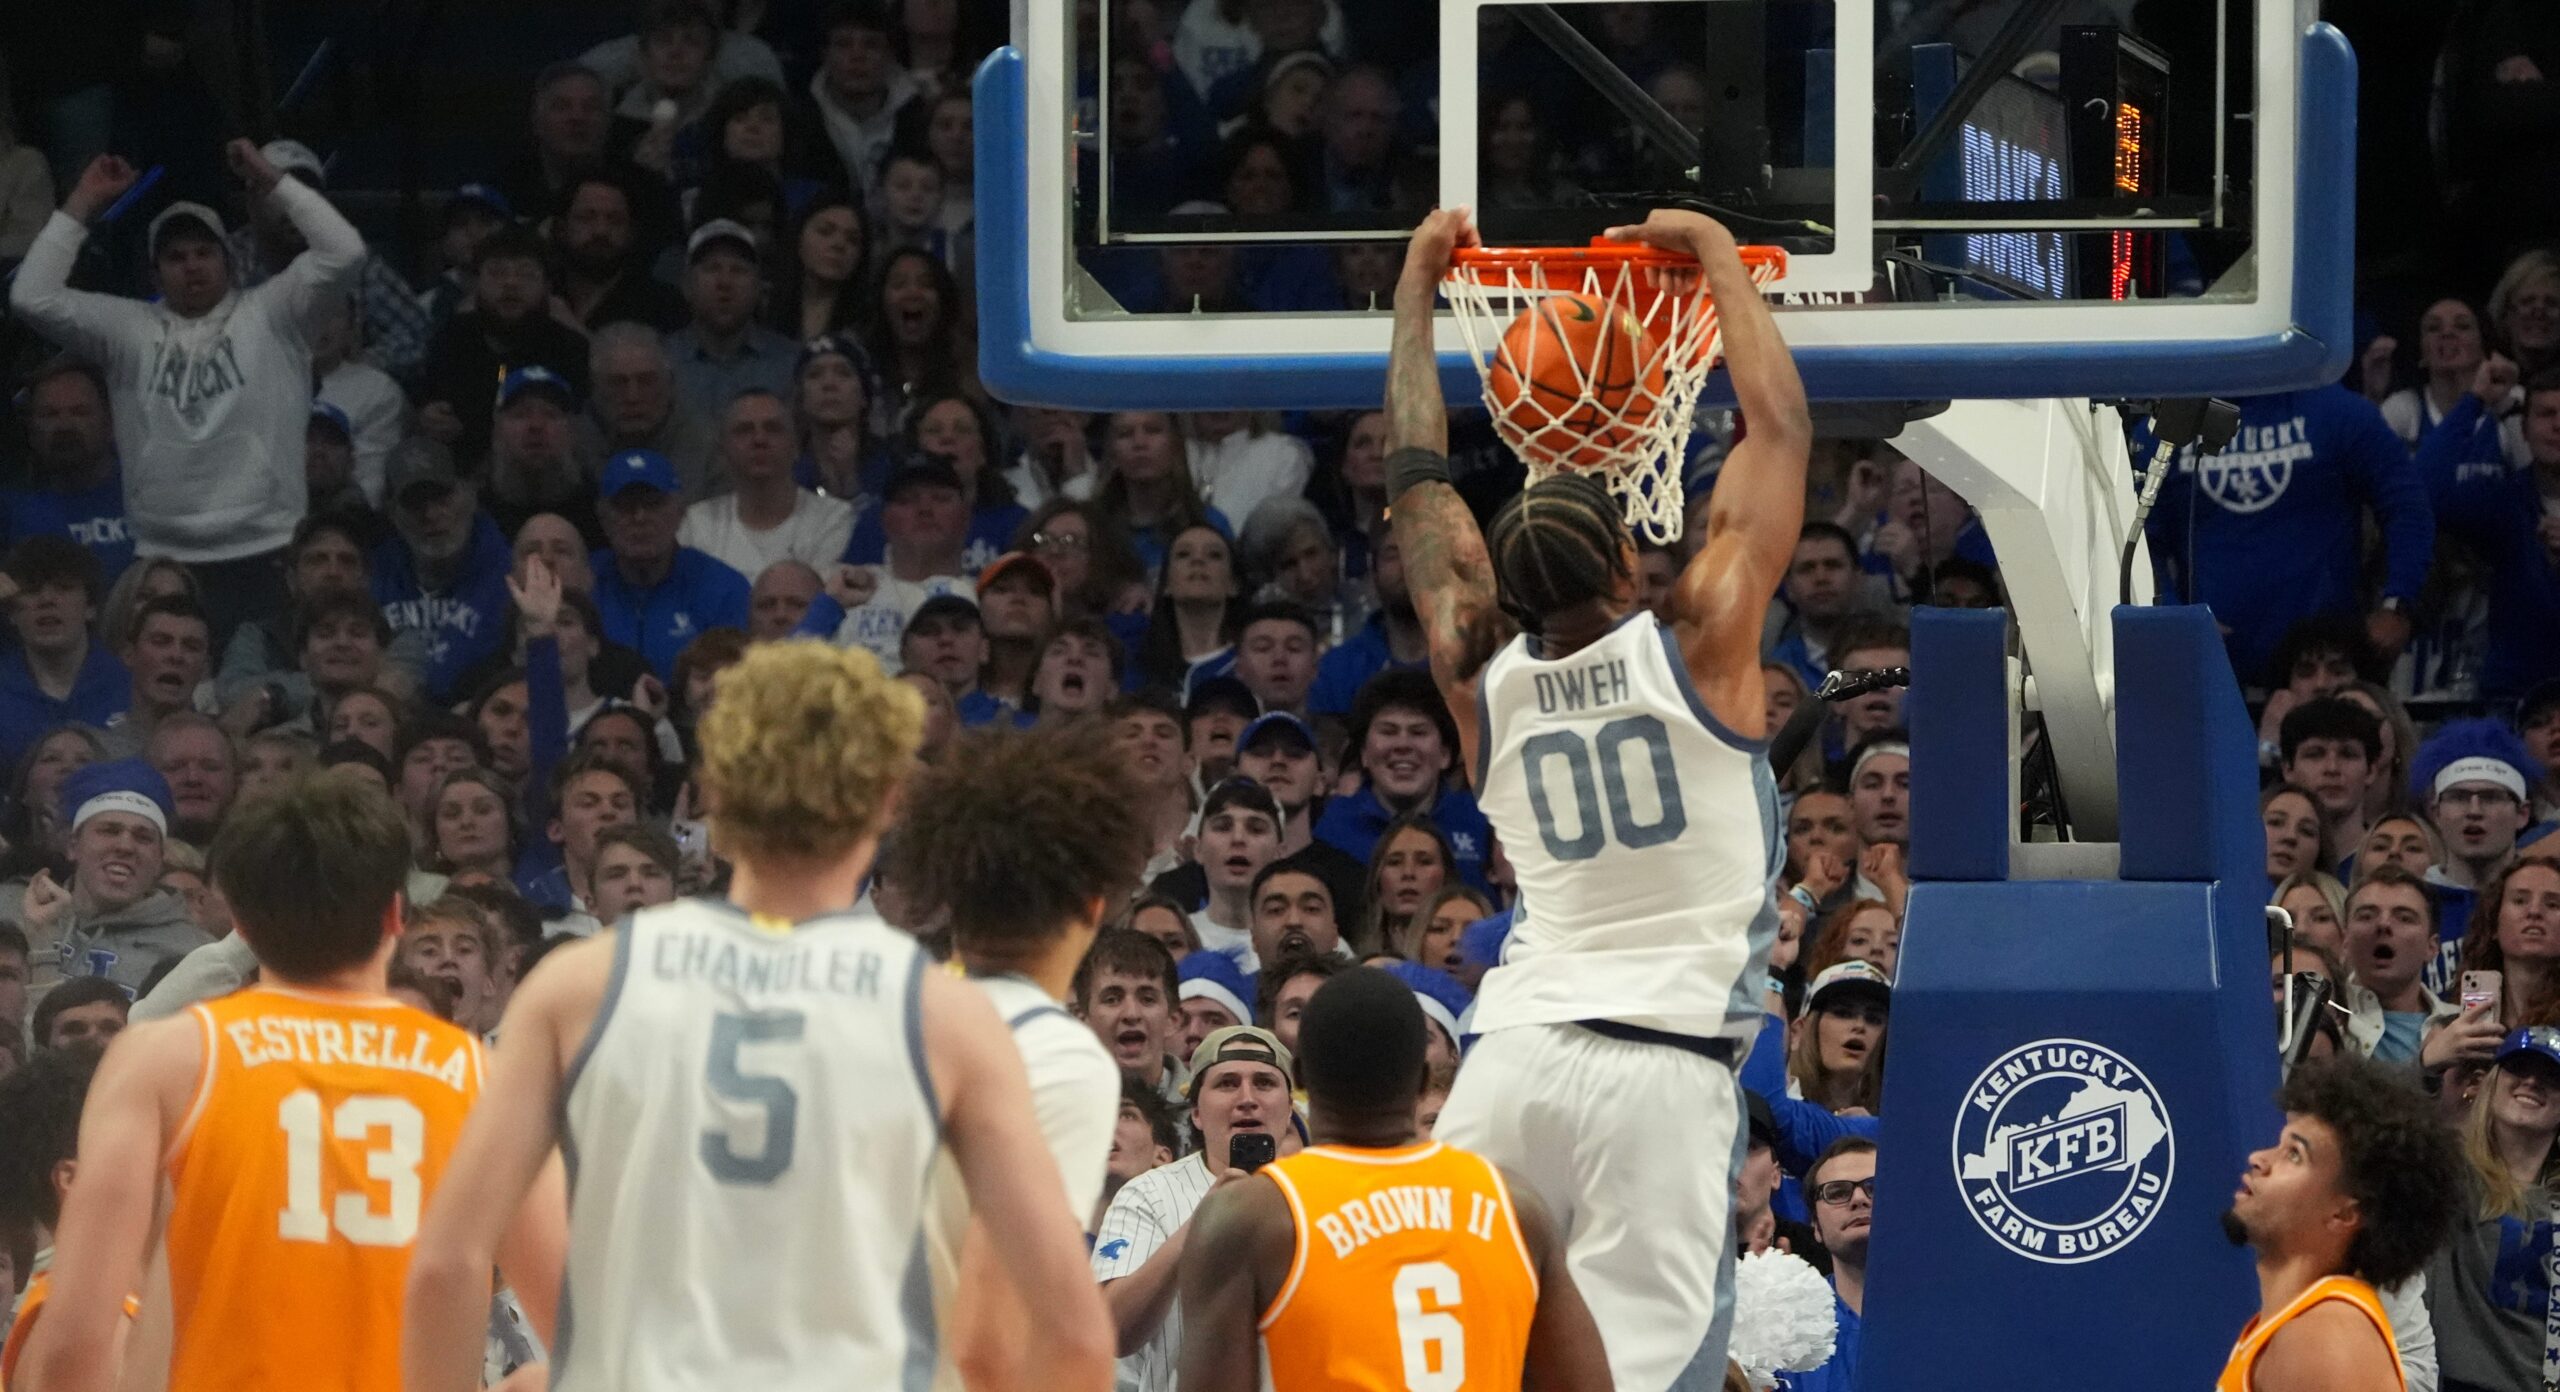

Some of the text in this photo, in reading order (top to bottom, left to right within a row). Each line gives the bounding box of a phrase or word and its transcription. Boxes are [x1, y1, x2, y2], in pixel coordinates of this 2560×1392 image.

[1534, 659, 1629, 714] OWEH
[1521, 714, 1687, 861] 00
[653, 932, 884, 997] CHANDLER
[226, 1015, 467, 1092] ESTRELLA
[1973, 1048, 2133, 1112] KENTUCKY
[700, 1008, 806, 1185] 5
[278, 1088, 425, 1248] 13
[2017, 1117, 2117, 1184] KFB
[1315, 1184, 1498, 1260] BROWN II
[1974, 1172, 2161, 1254] FARM BUREAU
[1393, 1260, 1466, 1392] 6
